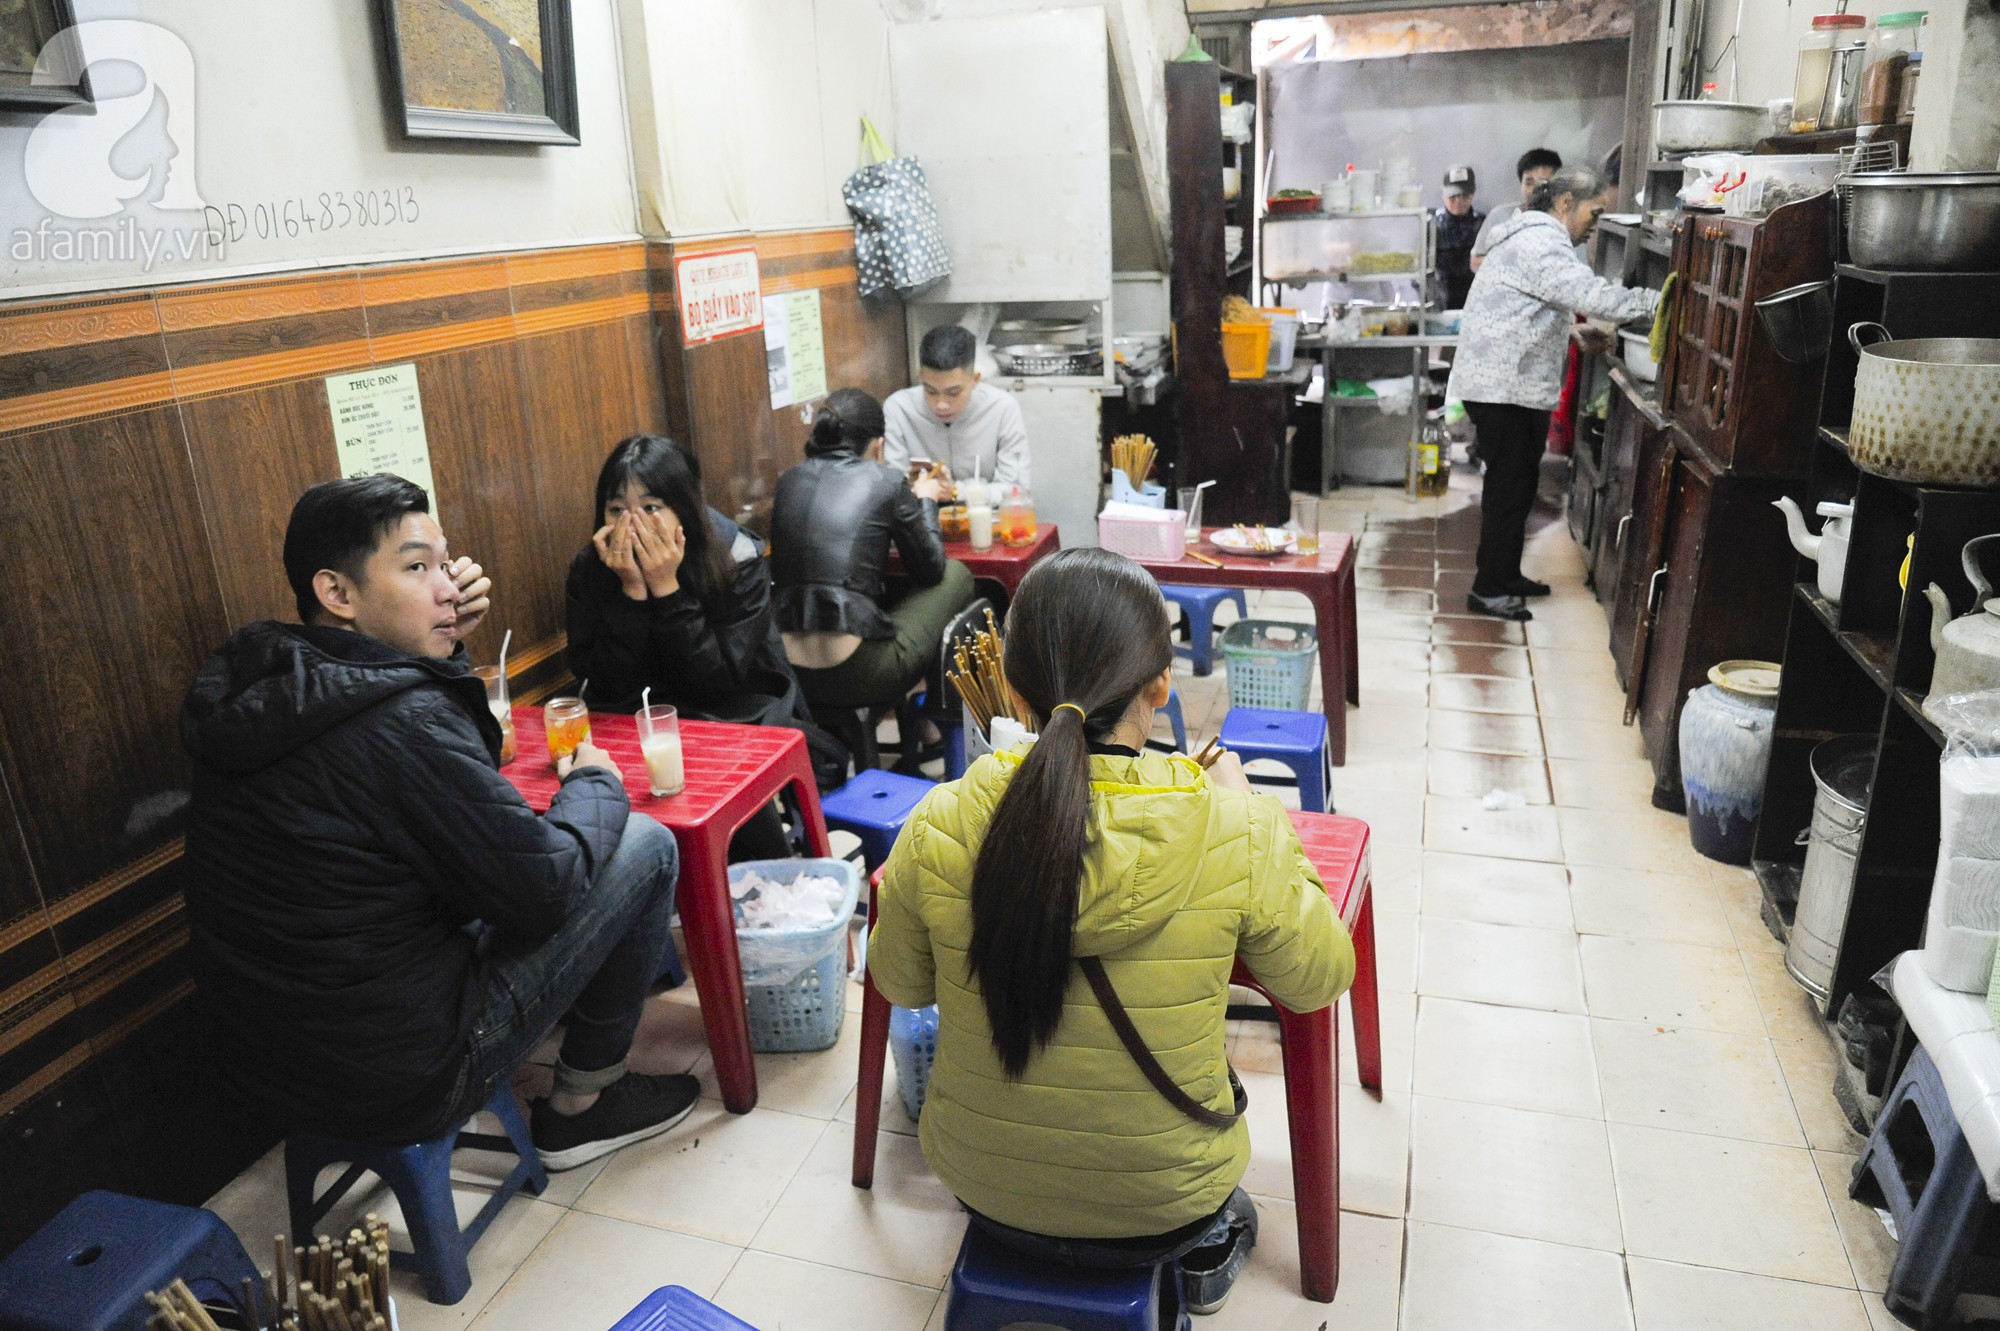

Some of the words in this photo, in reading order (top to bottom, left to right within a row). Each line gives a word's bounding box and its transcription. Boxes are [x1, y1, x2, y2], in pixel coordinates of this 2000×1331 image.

[254, 186, 420, 239] 01648380313
[688, 289, 701, 327] BỎ
[349, 377, 377, 391] THỰC
